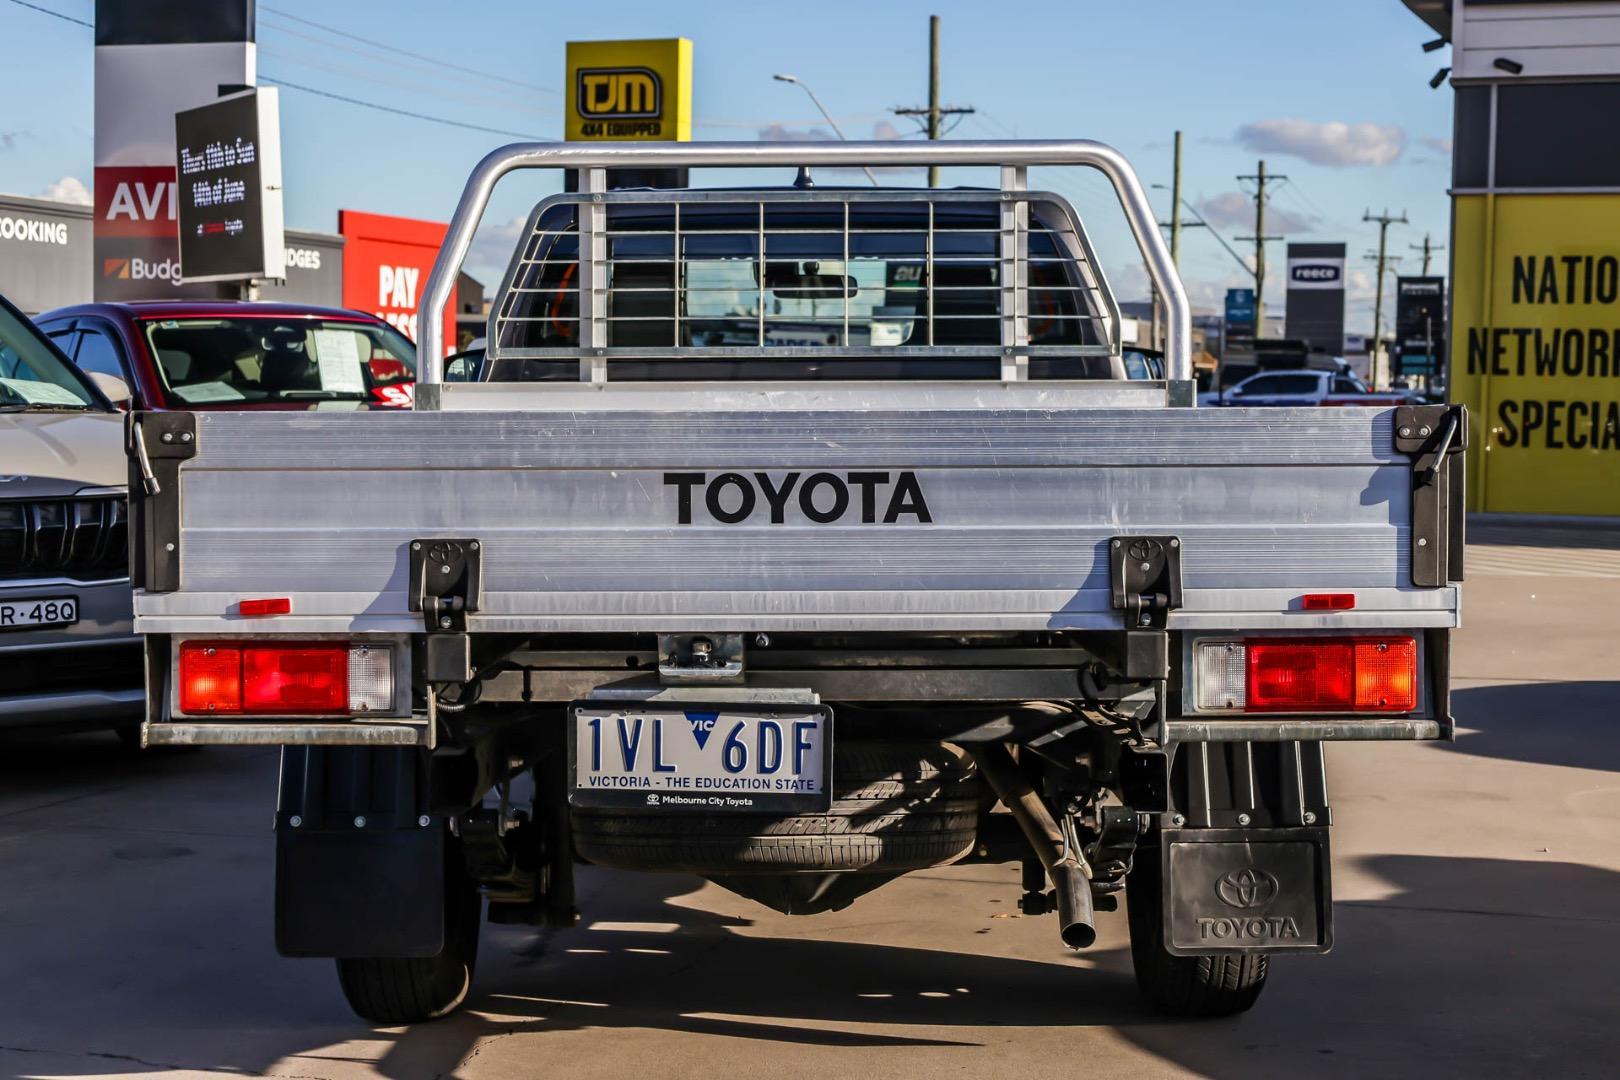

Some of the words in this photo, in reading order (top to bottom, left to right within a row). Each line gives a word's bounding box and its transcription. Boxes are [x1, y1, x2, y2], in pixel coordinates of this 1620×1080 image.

[583, 73, 655, 113] TJM
[607, 122, 661, 136] EQUIPPED
[106, 182, 177, 221] AVI
[0, 217, 68, 245] OOKING
[379, 265, 419, 309] PAY
[1296, 268, 1336, 279] reece
[1511, 255, 1618, 305] NATIO
[1497, 399, 1620, 451] SPECIA
[663, 471, 933, 525] TOYOTA
[689, 719, 714, 732] VIC
[588, 718, 677, 773] 1VL
[721, 720, 818, 775] 6DF
[589, 775, 651, 787] VICTORIA
[665, 777, 690, 788] THE
[695, 777, 771, 789] EDUCATION
[775, 778, 814, 790] STATE
[662, 795, 707, 805] Melbourne
[708, 796, 725, 807] City
[725, 797, 753, 807] Toyota
[1196, 917, 1300, 939] TOYOTA
